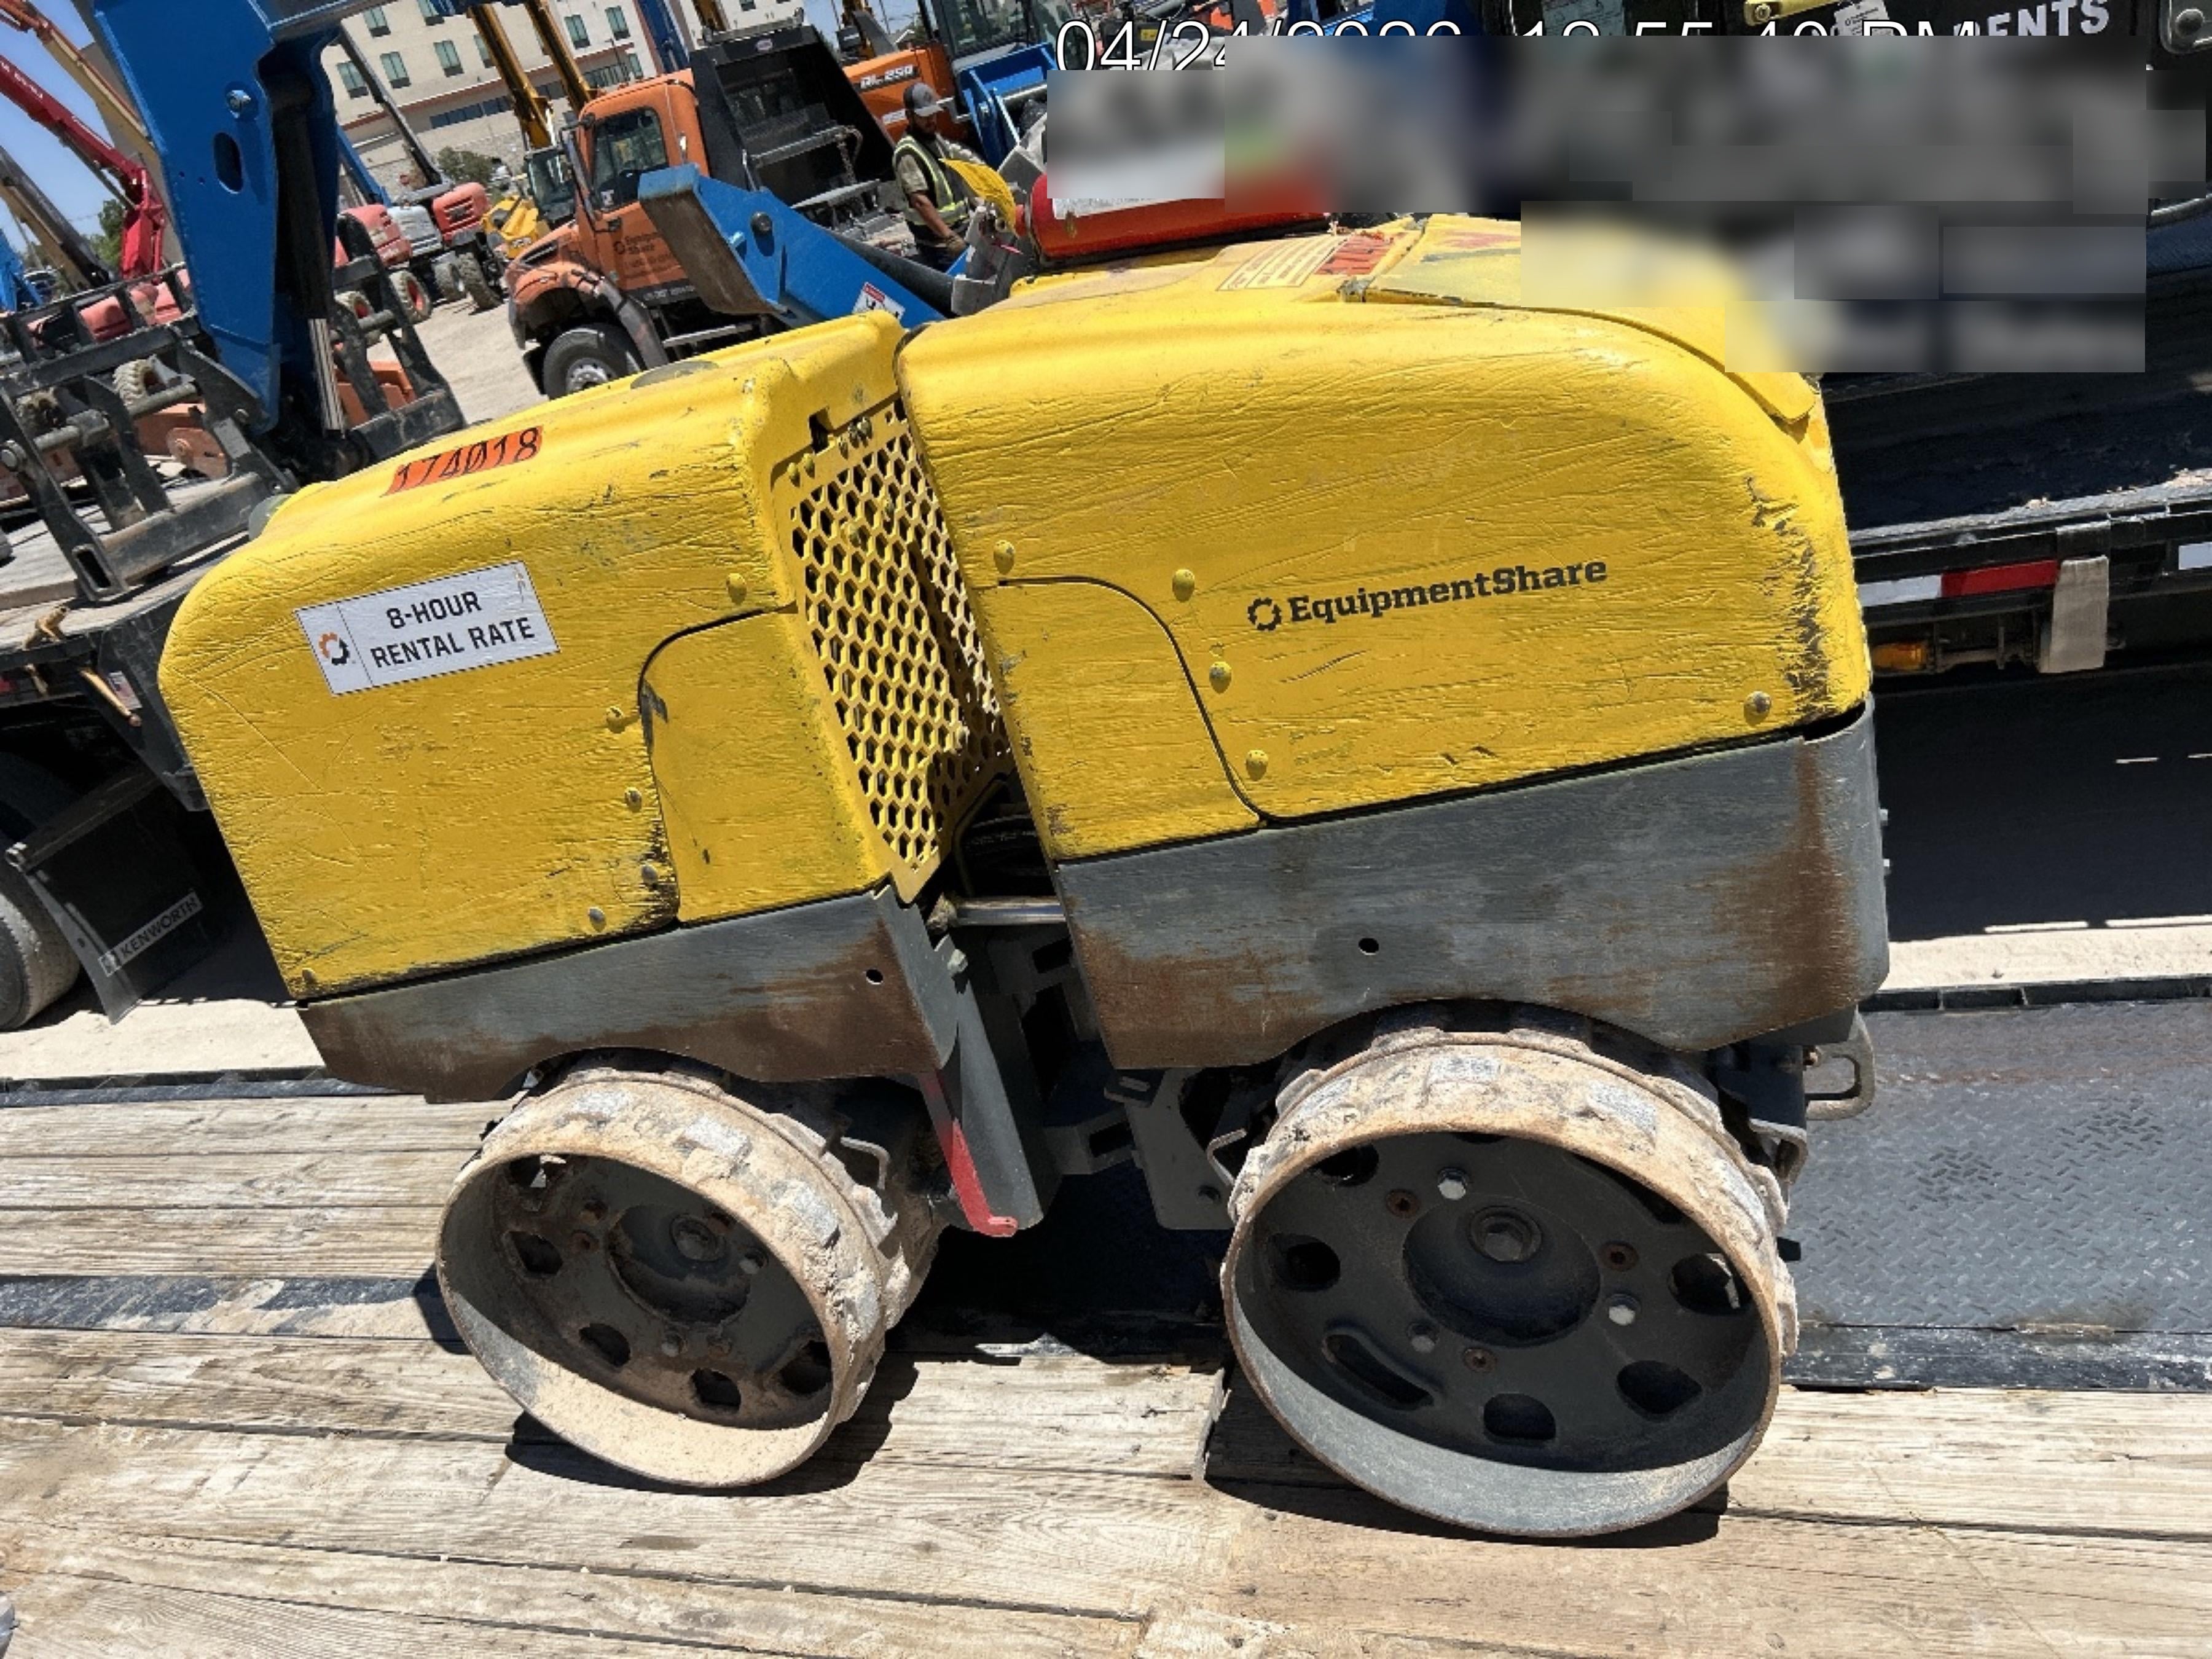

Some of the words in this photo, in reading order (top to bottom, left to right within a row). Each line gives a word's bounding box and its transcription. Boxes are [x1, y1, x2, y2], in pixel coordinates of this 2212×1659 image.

[1953, 0, 2110, 36] ENTS
[396, 426, 539, 491] 174018
[386, 591, 482, 629] 8-HOUR
[1288, 560, 1607, 624] EquipmentShare
[370, 632, 465, 669] RENTAL
[468, 617, 535, 649] RATE
[120, 897, 197, 959] KENWORTH
